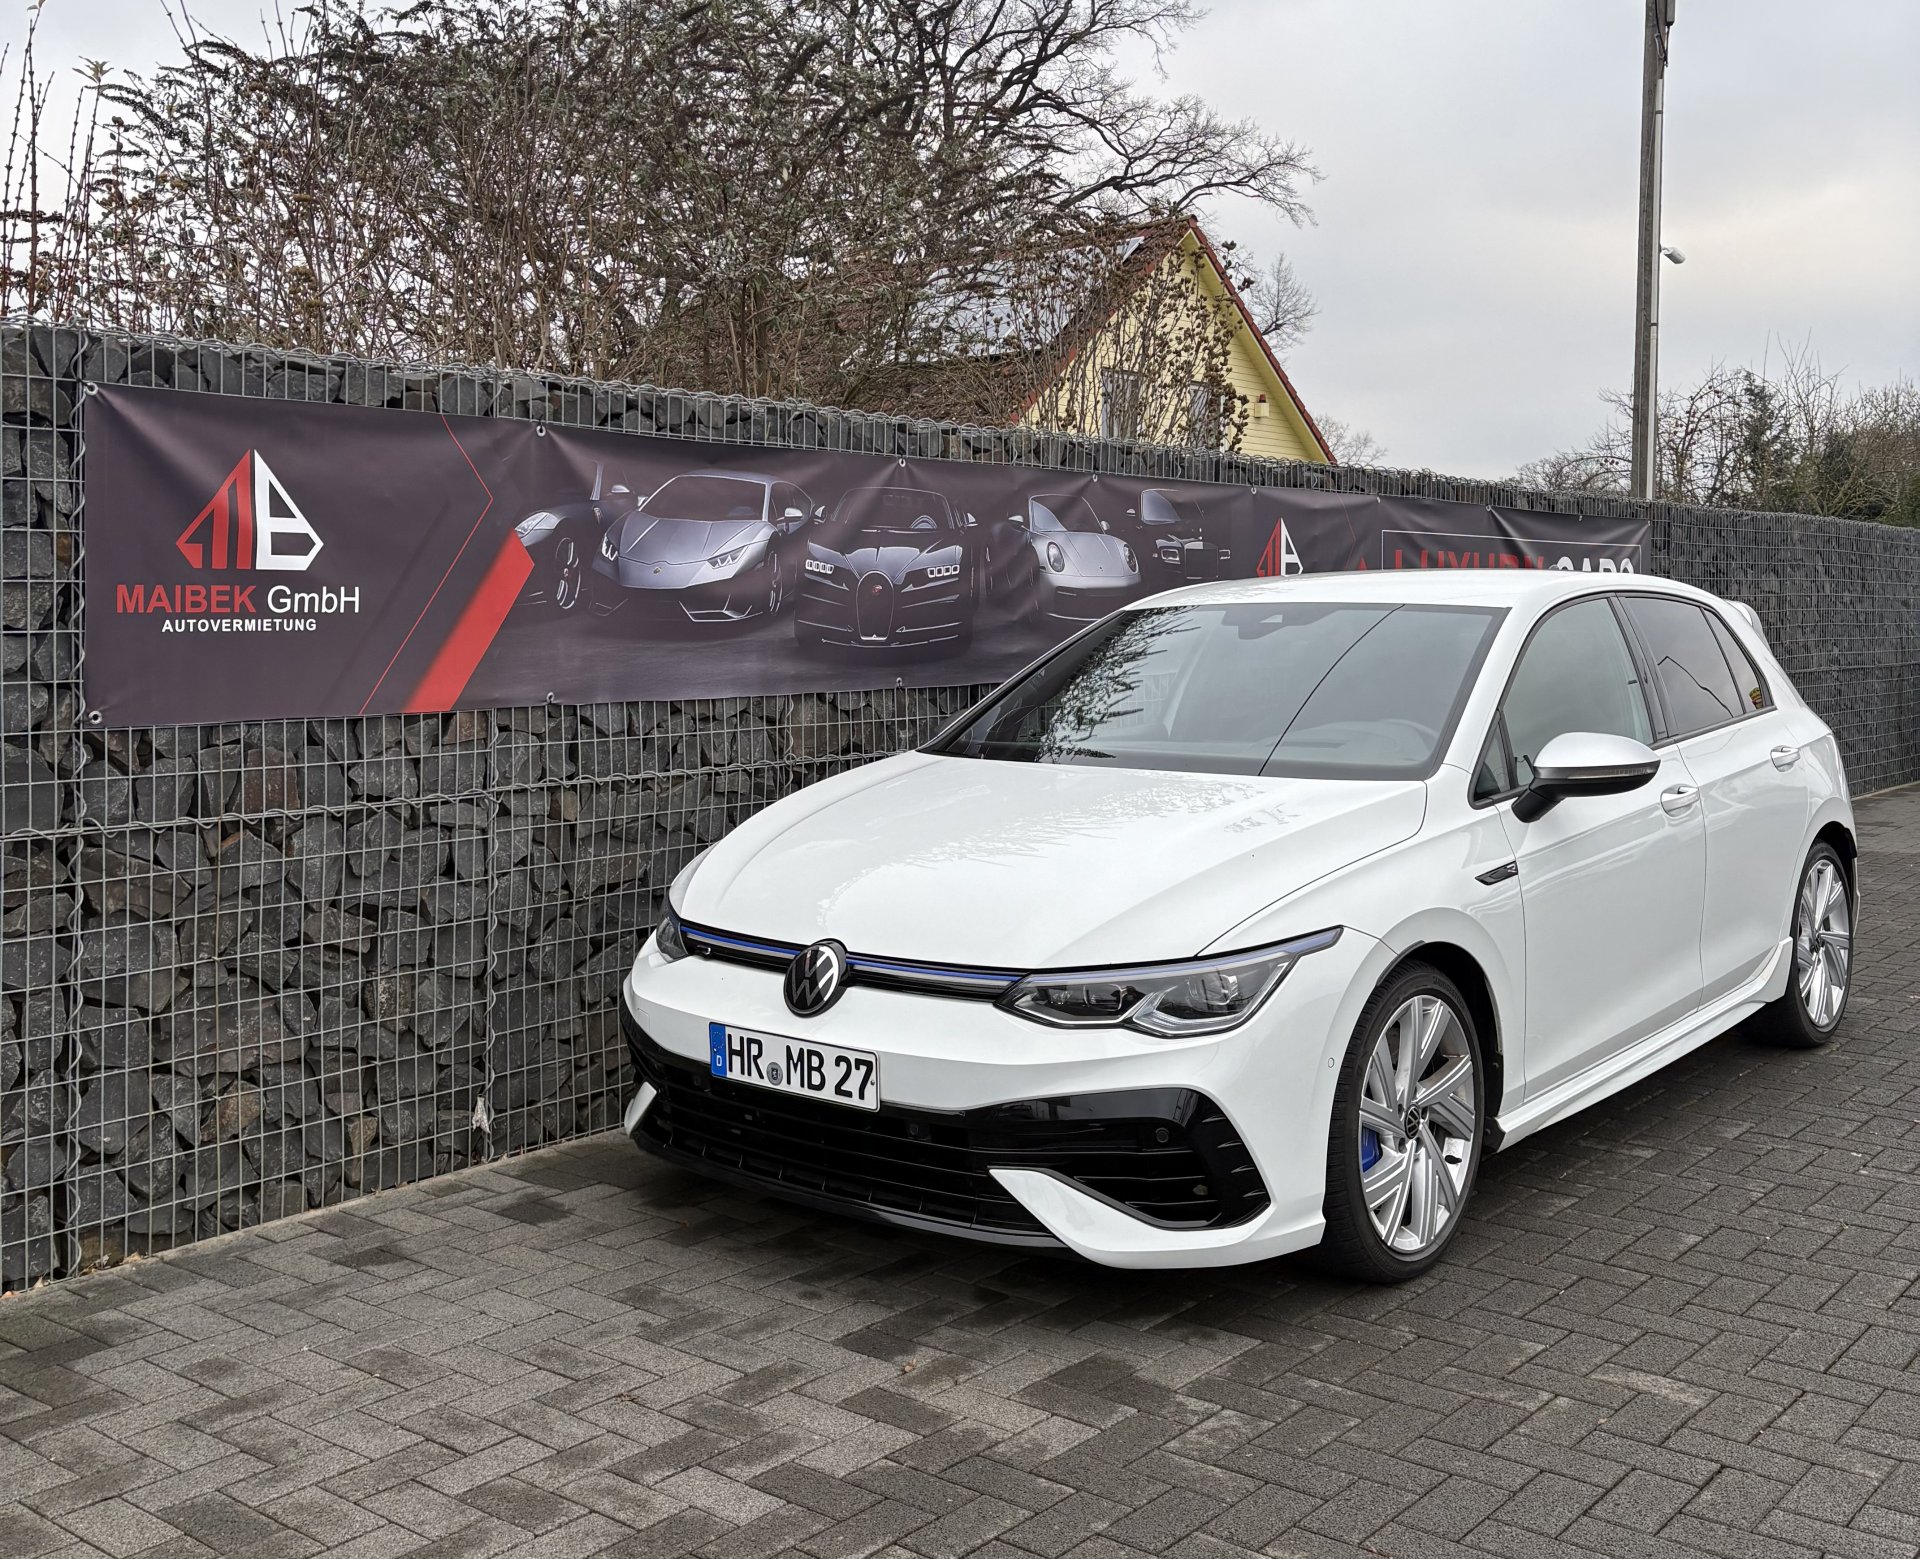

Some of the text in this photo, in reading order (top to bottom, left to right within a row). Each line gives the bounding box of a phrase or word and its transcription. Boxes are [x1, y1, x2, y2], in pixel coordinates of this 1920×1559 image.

[115, 584, 360, 614] MAIBEK GmbH
[161, 617, 318, 634] AUTOVERMIETUNG
[716, 1055, 723, 1067] D
[727, 1033, 765, 1080] HR
[786, 1044, 826, 1092] MB
[834, 1055, 874, 1101] 27
